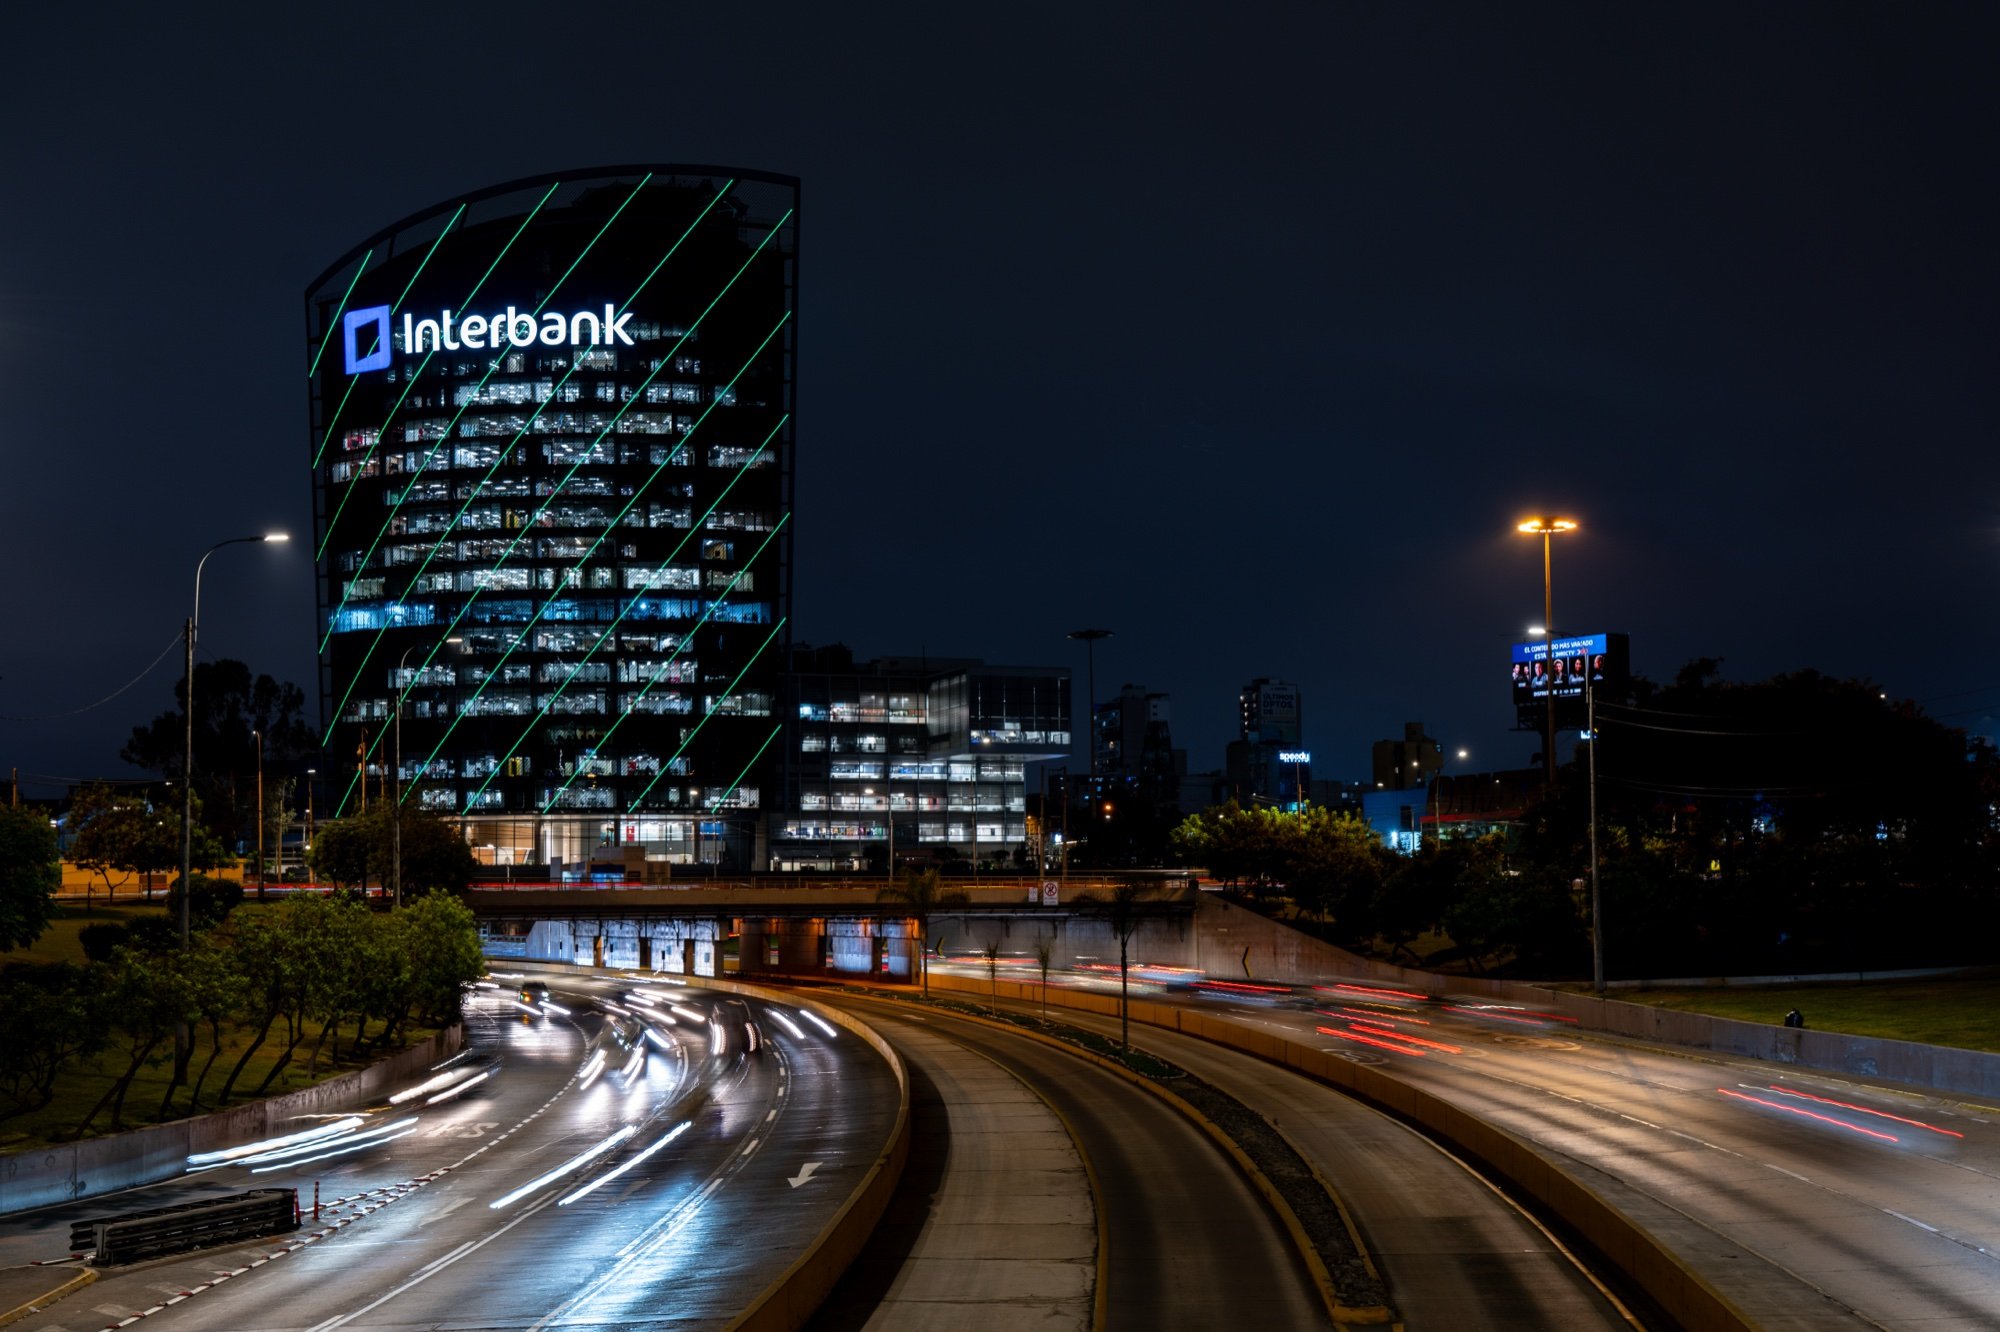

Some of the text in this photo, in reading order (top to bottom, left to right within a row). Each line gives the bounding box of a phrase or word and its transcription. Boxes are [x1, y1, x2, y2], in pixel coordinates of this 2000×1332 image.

[403, 303, 635, 354] Interbank
[1524, 646, 1531, 654] EL
[1279, 752, 1310, 763] speedy
